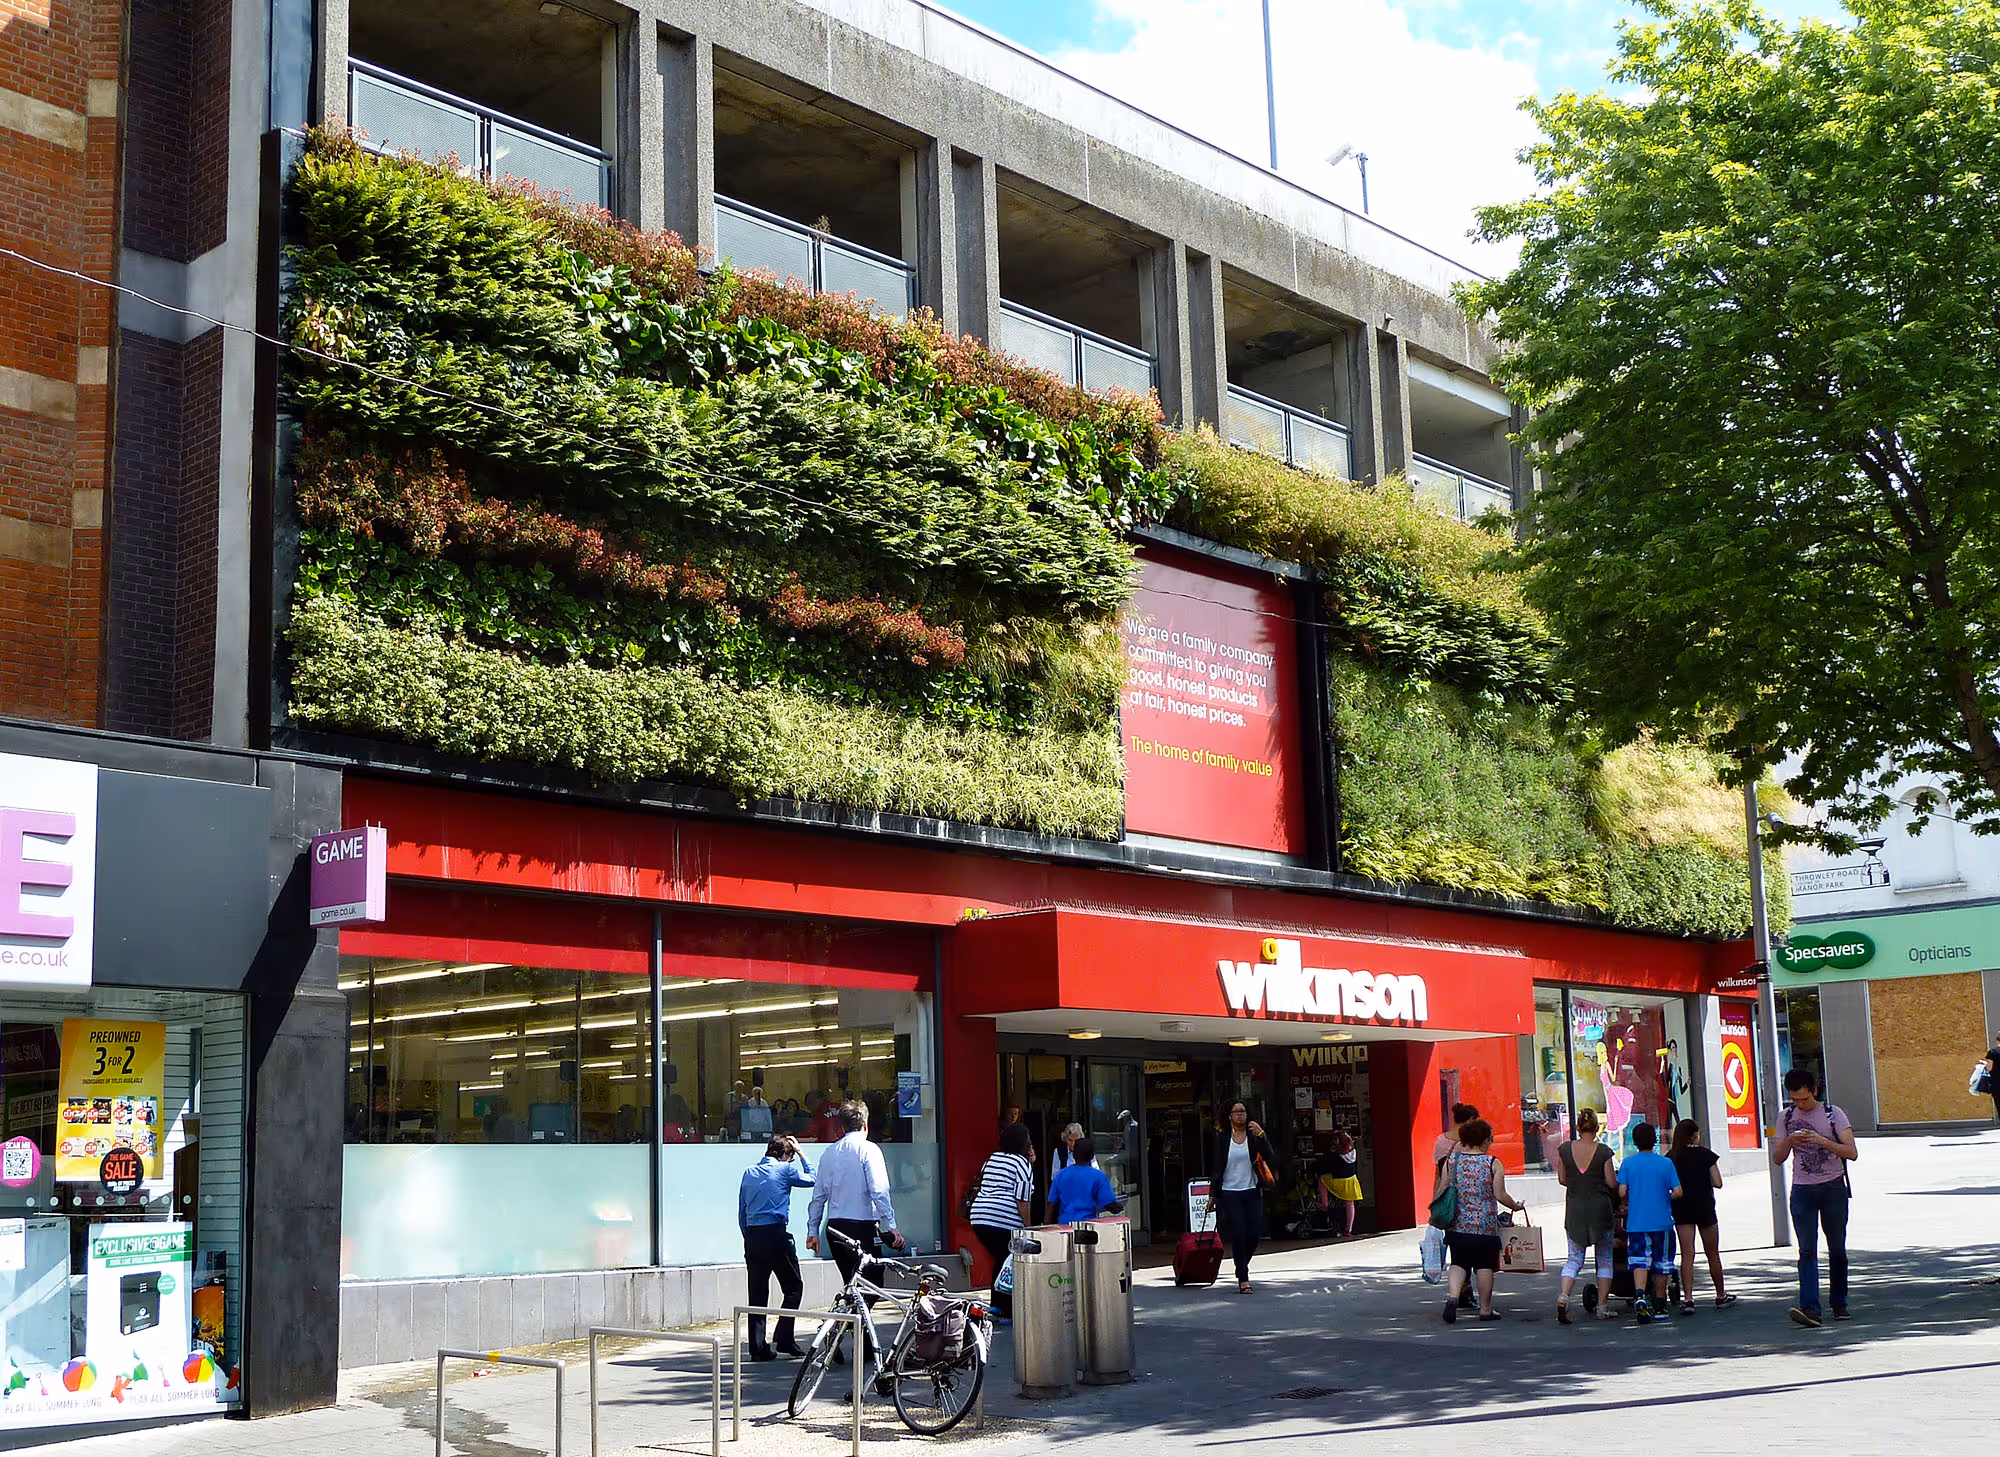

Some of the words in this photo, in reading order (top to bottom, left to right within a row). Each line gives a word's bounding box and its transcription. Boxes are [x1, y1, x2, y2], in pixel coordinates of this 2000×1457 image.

[1127, 618, 1146, 636] We
[1148, 625, 1168, 642] are
[1171, 632, 1180, 645] a
[1182, 632, 1217, 656] family
[1220, 644, 1273, 670] company
[1128, 643, 1192, 671] committed
[1195, 656, 1206, 673] to
[1209, 662, 1243, 686] giving
[1246, 671, 1267, 688] you
[1129, 667, 1166, 688] good,
[1167, 672, 1206, 695] honest
[1209, 685, 1258, 707] products
[1130, 689, 1143, 705] at
[1145, 691, 1166, 712] fair,
[1168, 696, 1207, 719] honest
[1209, 708, 1247, 727] prices.
[1131, 735, 1152, 754] The
[1155, 740, 1189, 761] home
[1192, 748, 1204, 764] of
[1205, 751, 1240, 773] family
[1242, 760, 1273, 776] value
[316, 836, 363, 865] GAME
[0, 806, 76, 940] E
[1795, 872, 1835, 882] THROWLEY
[1837, 869, 1859, 877] ROAD
[1795, 882, 1824, 892] MANOR
[321, 905, 357, 920] game.co.uk
[1785, 943, 1865, 963] Specsavers
[1908, 945, 1972, 964] Opticians
[1217, 937, 1428, 1022] wilkinson
[1571, 1004, 1608, 1027] SUMMER
[89, 1031, 141, 1043] PREOWNED
[92, 1046, 107, 1076] 3
[107, 1056, 122, 1066] FOR
[121, 1045, 135, 1074] 2
[5, 1141, 20, 1149] SCAN
[21, 1141, 31, 1149] ME
[109, 1153, 119, 1161] THE
[104, 1161, 137, 1180] SALE
[95, 1233, 187, 1255] EXCLUSIVE@GAME
[4, 1402, 26, 1414] PLAY
[45, 1399, 80, 1411] SUMMER
[82, 1396, 102, 1407] LONG
[129, 1393, 149, 1405] PLAY
[151, 1391, 166, 1402] ALL
[167, 1390, 199, 1402] SUMMER
[201, 1387, 220, 1399] LONG
